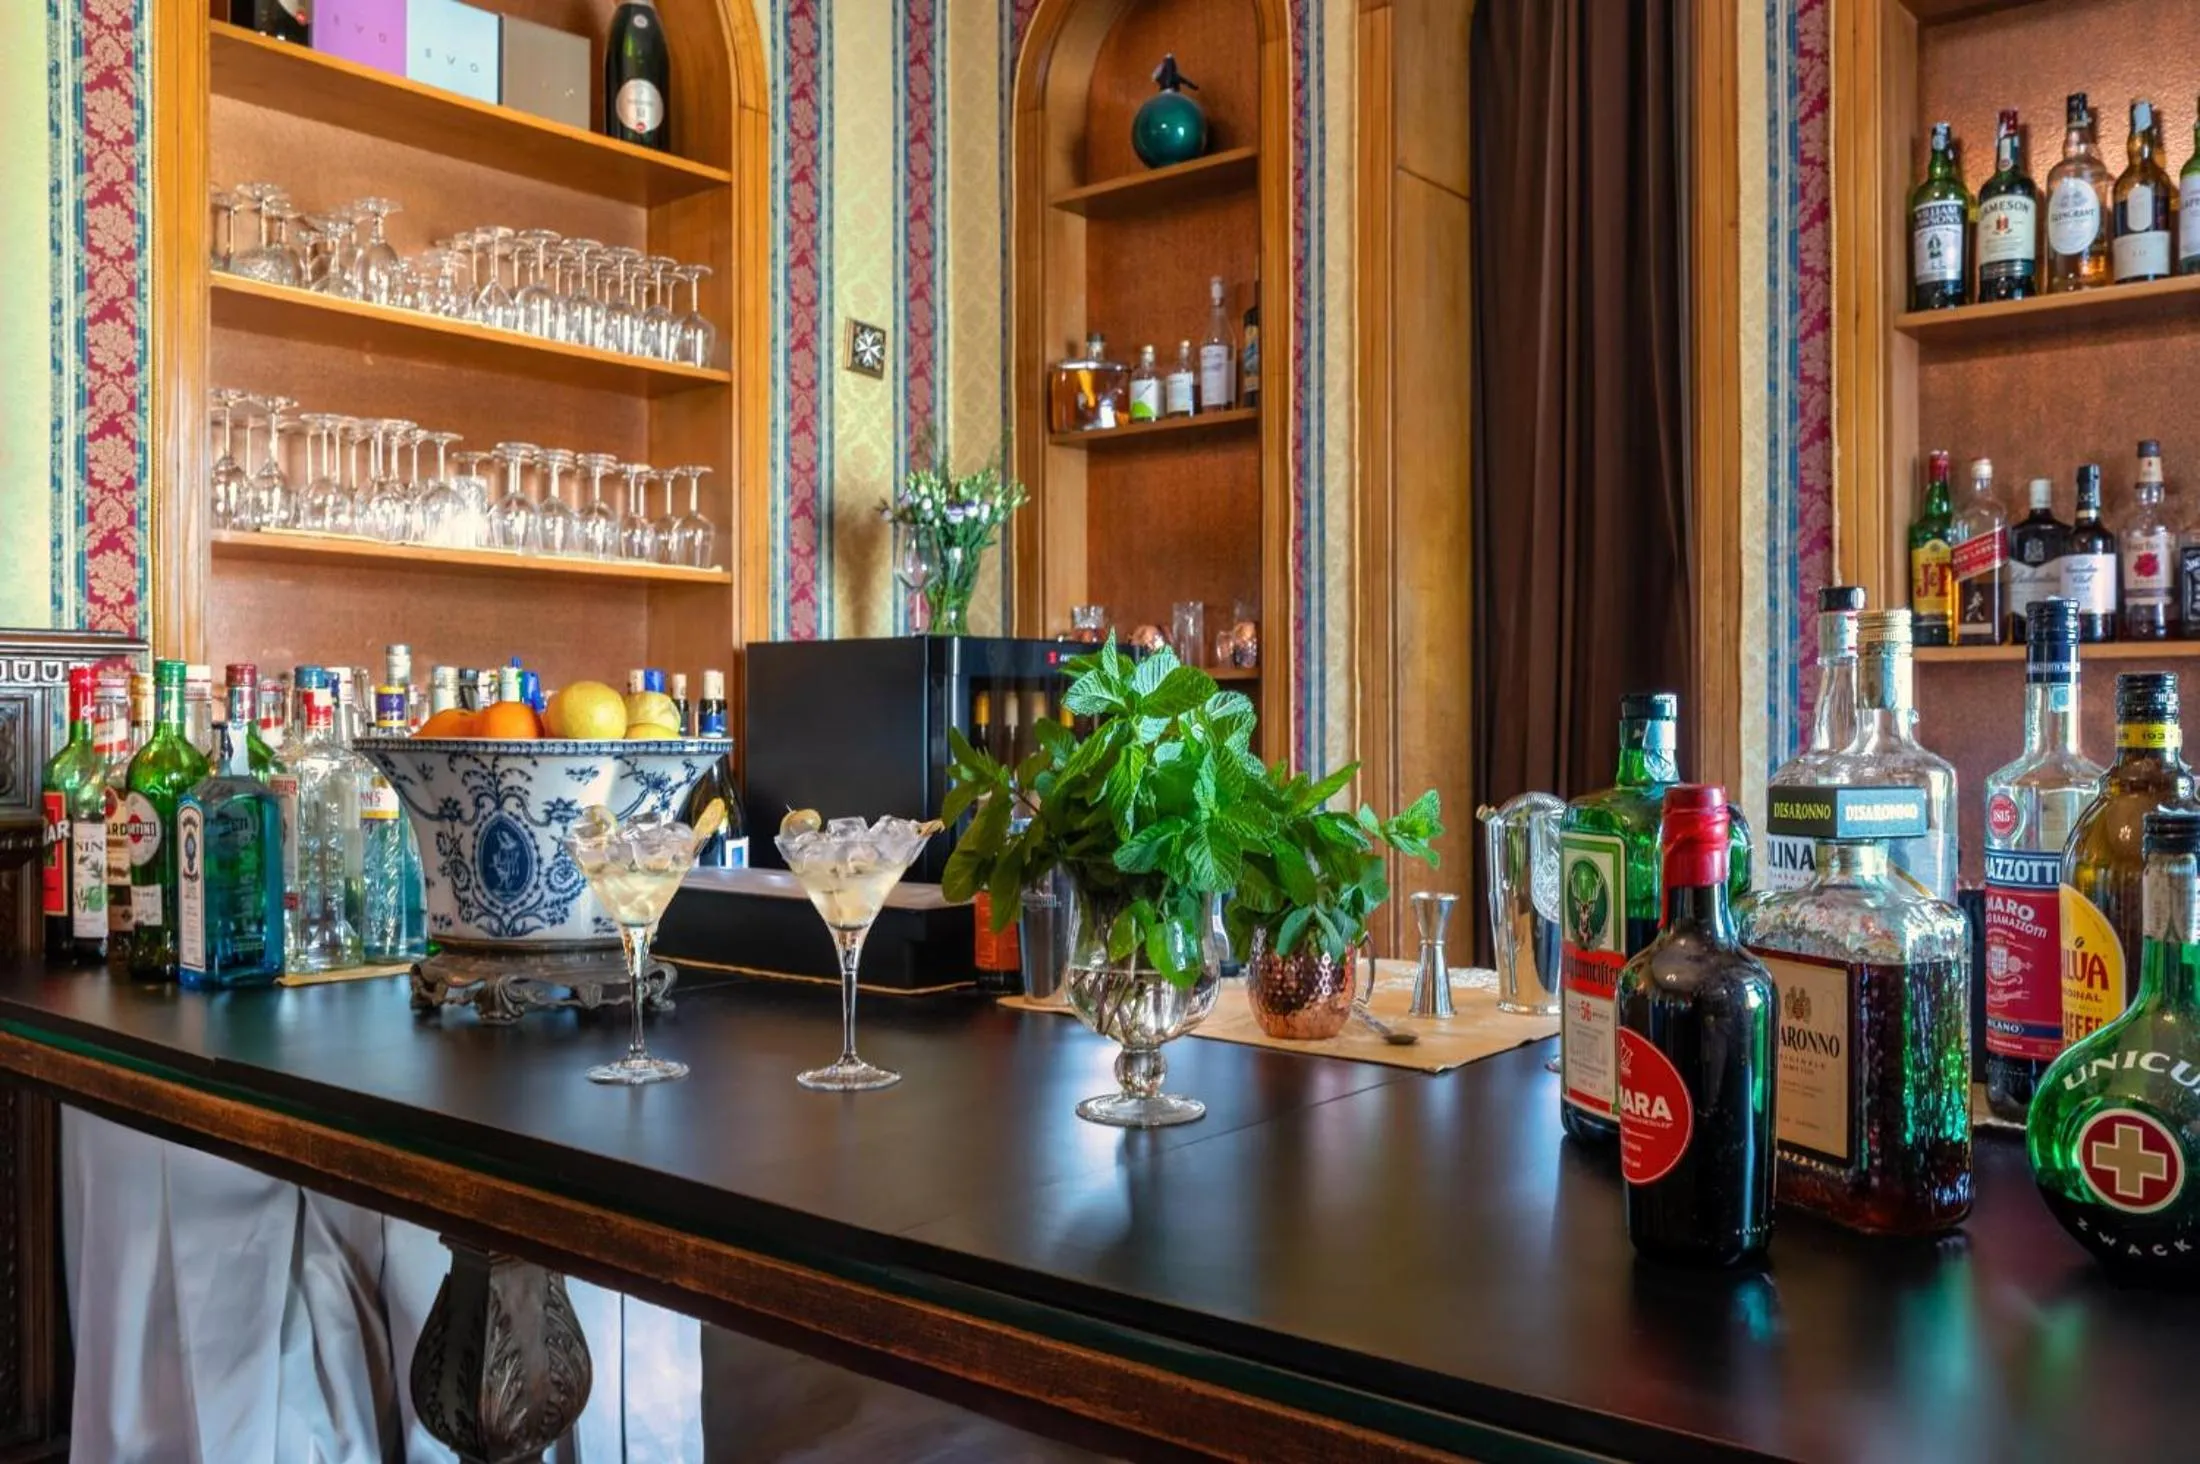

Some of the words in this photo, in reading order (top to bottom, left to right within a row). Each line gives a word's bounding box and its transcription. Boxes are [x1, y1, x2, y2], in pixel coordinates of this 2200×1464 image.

[1773, 802, 1832, 821] DISARONNO
[1845, 803, 1919, 822] DISARONNO
[1993, 809, 2010, 822] 1815
[1985, 858, 2061, 884] AZZOTTI
[2063, 1050, 2200, 1096] UNICU
[2077, 1217, 2193, 1256] ZWACK
